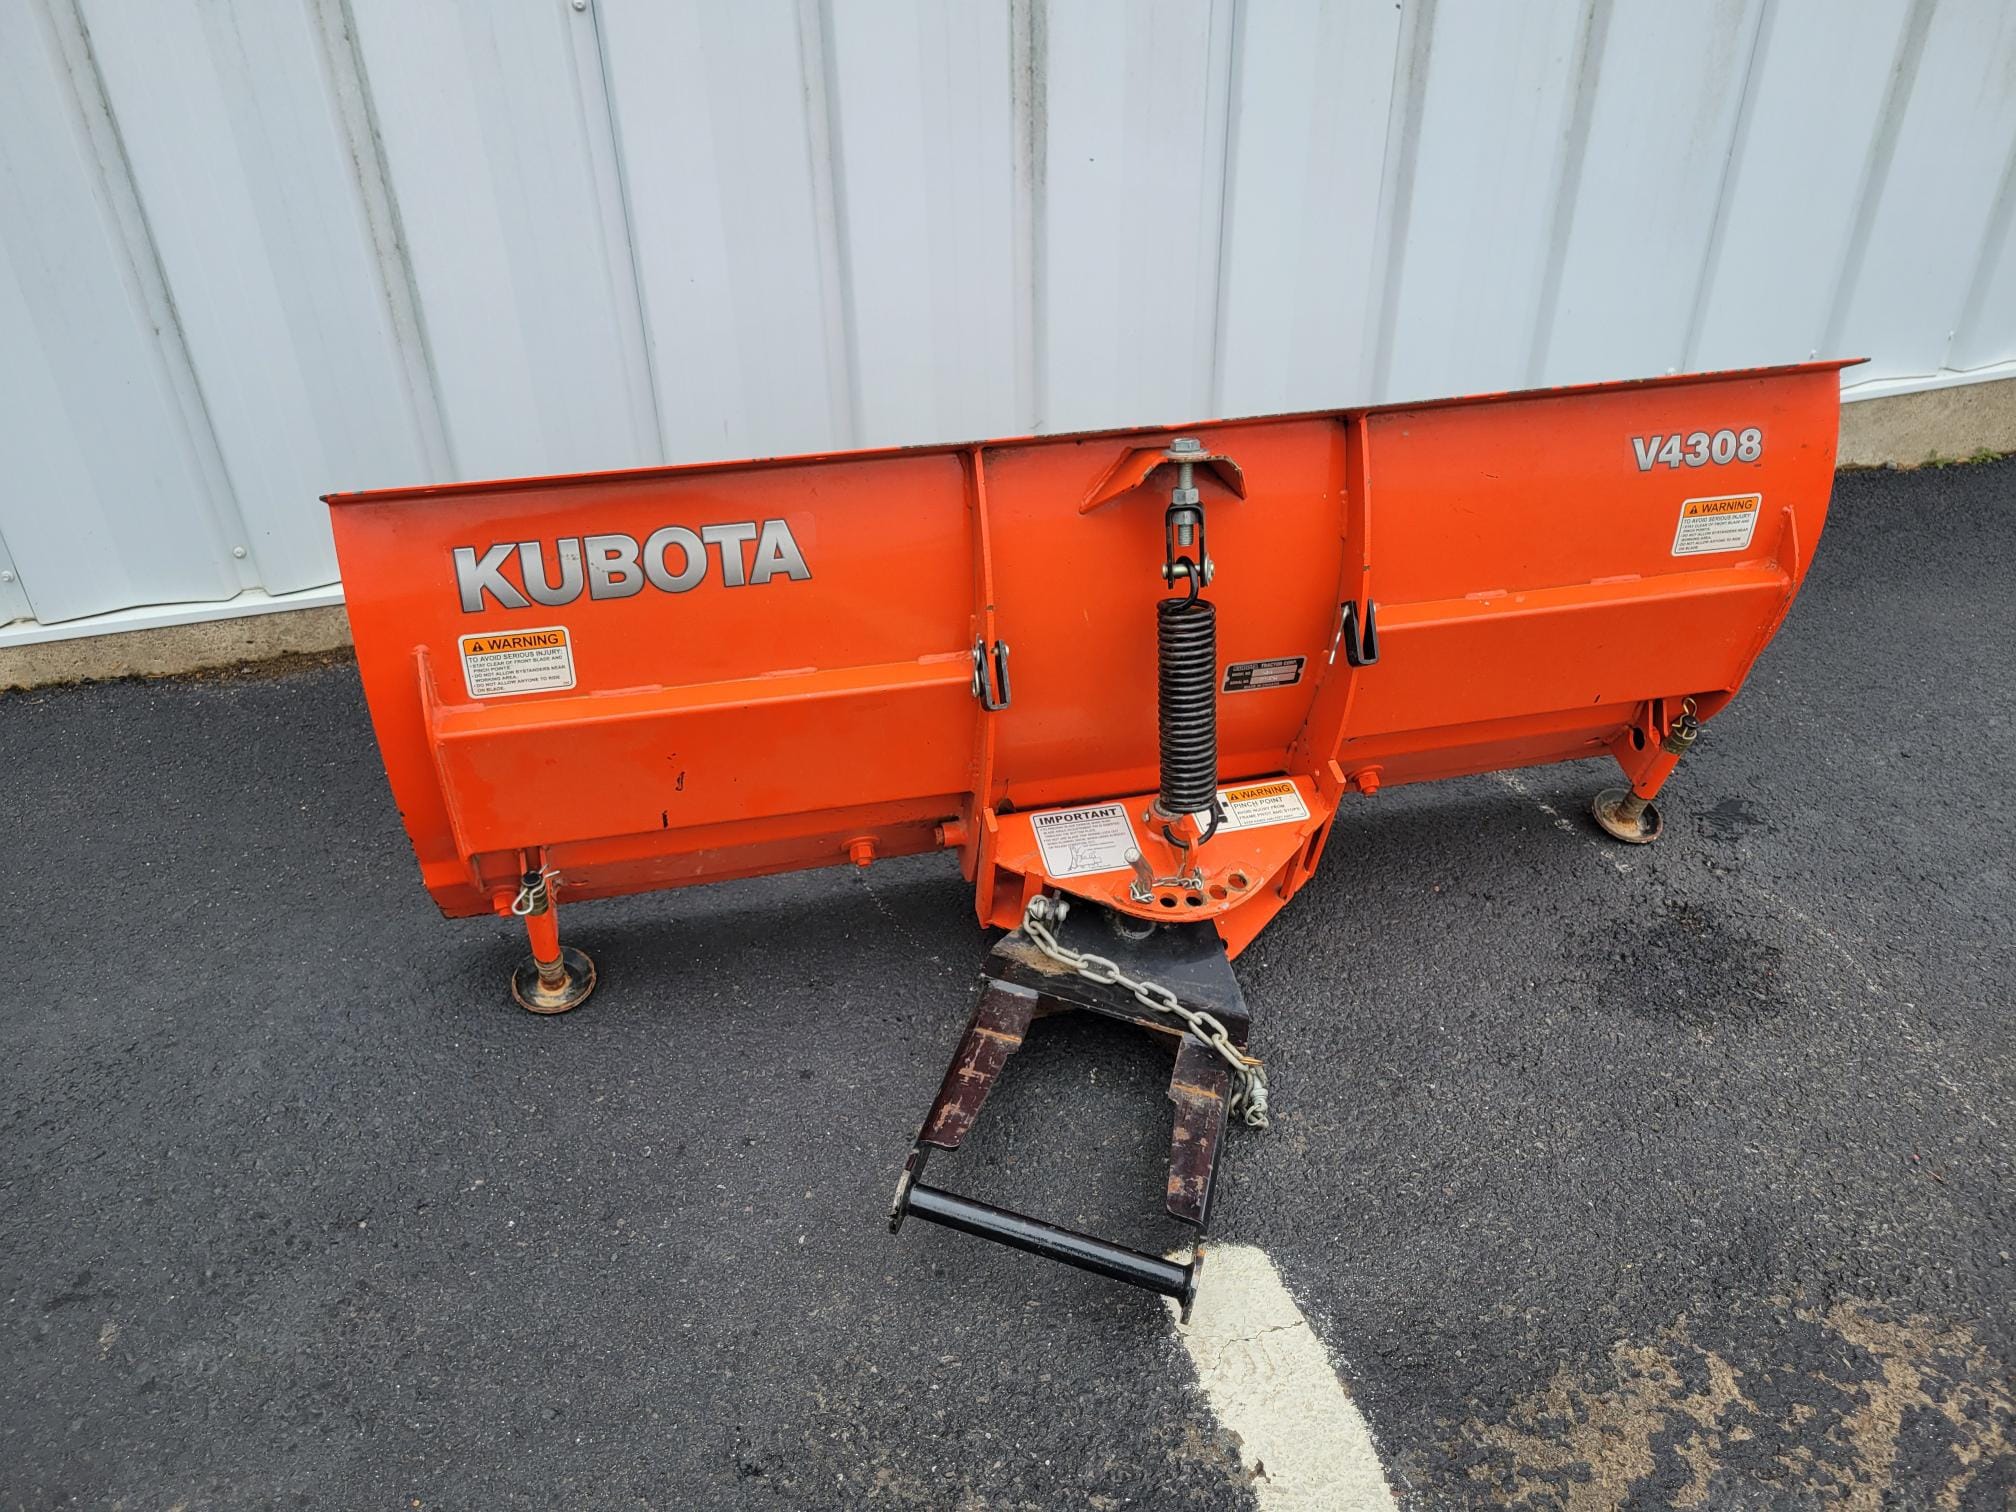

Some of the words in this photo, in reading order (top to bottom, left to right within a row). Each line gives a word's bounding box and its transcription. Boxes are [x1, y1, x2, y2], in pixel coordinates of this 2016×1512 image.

[1632, 426, 1763, 471] V4308
[1702, 500, 1753, 513] WARNING
[453, 519, 812, 613] KUBOTA
[487, 633, 559, 650] WARNING
[480, 654, 501, 662] AVOID
[503, 651, 534, 660] SERIOUS
[1240, 784, 1290, 798] WARNING
[1233, 801, 1258, 809] PINCH
[1260, 796, 1283, 805] POINT
[1039, 808, 1117, 825] IMPORTANT
